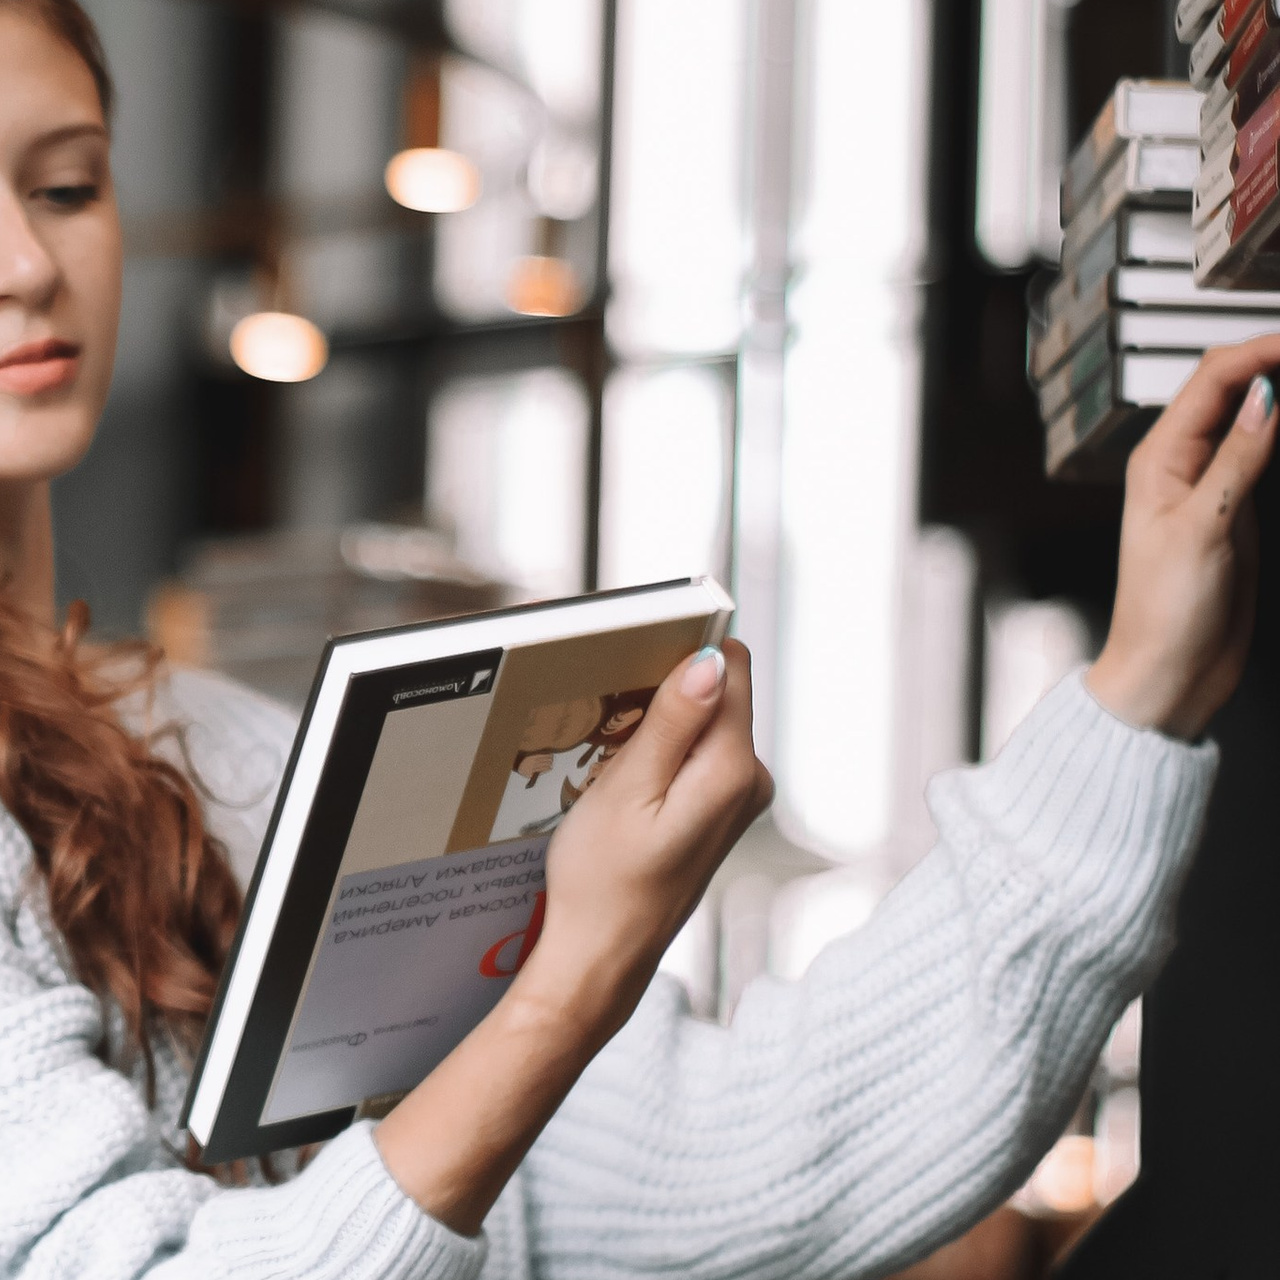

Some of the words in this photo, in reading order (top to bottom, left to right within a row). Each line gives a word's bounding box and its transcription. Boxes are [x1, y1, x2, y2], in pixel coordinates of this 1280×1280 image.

[435, 849, 542, 881] продажи
[339, 873, 428, 900] Аляски
[473, 869, 546, 894] ервых
[333, 886, 463, 926] поселений
